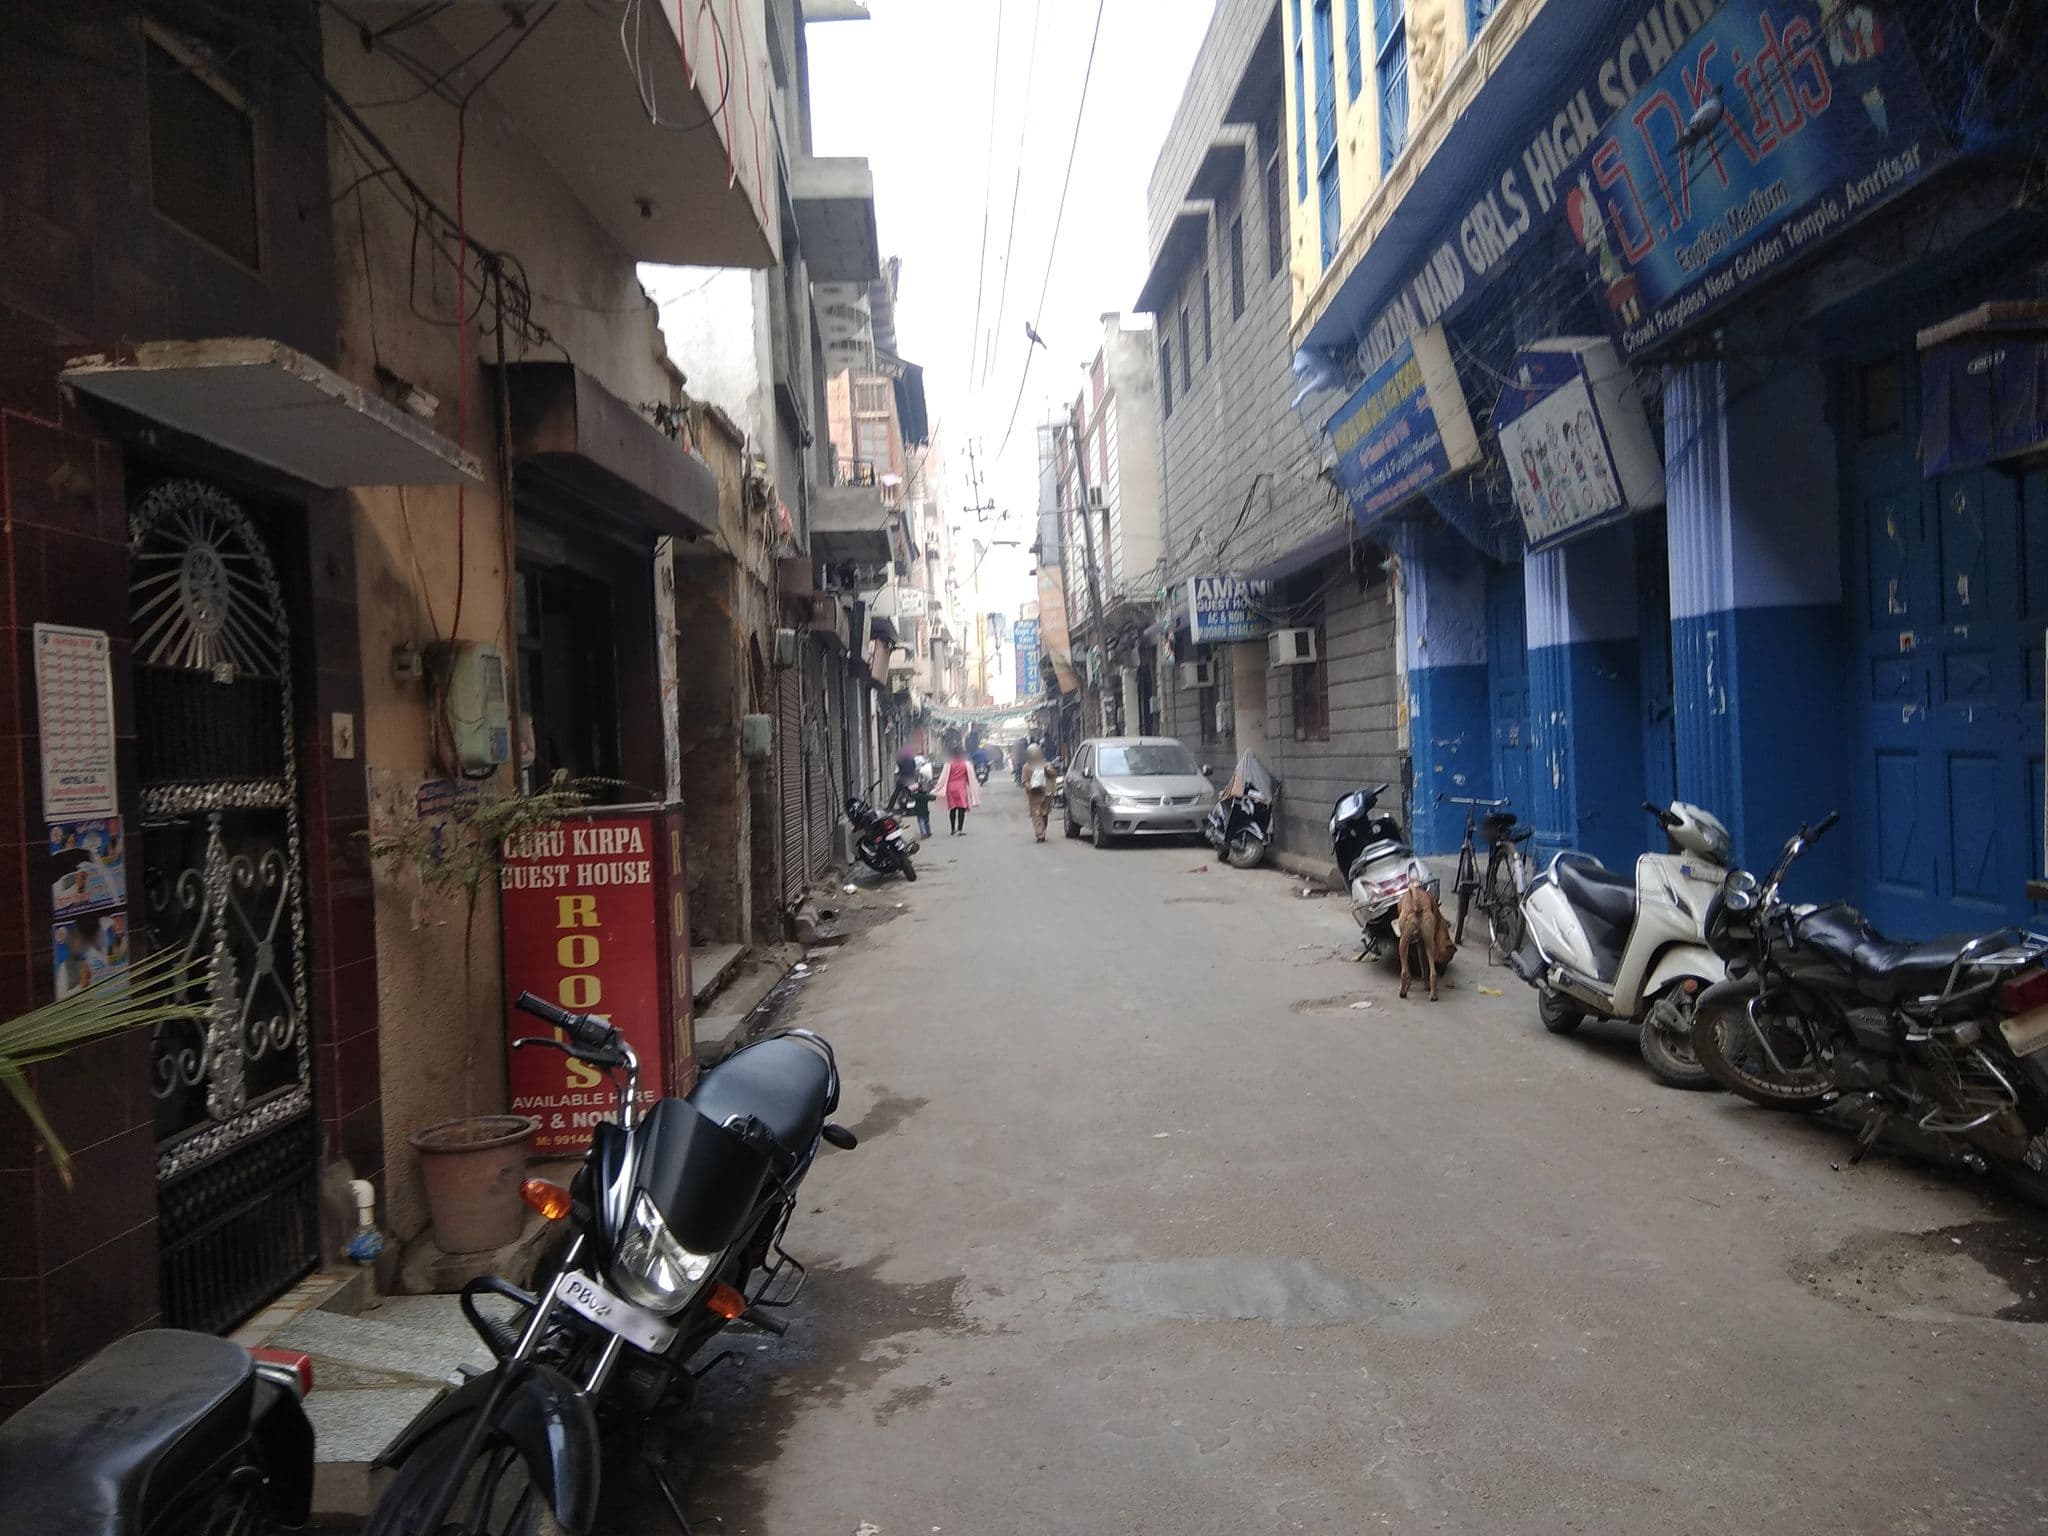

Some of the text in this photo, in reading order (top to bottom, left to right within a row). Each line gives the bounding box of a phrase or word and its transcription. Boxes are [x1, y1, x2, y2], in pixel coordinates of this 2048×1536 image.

[1461, 168, 1529, 276] GIRLS
[1522, 87, 1600, 215] HIGH
[1704, 268, 1736, 300] Near
[1734, 241, 1784, 281] Golden
[1780, 199, 1846, 249] Temple,
[1844, 143, 1922, 211] Amritsar
[572, 826, 645, 857] KIRPA
[501, 860, 651, 890] GUEST HOUSE
[512, 1089, 655, 1109] AVAILABLE HRE
[550, 1113, 567, 1130] &
